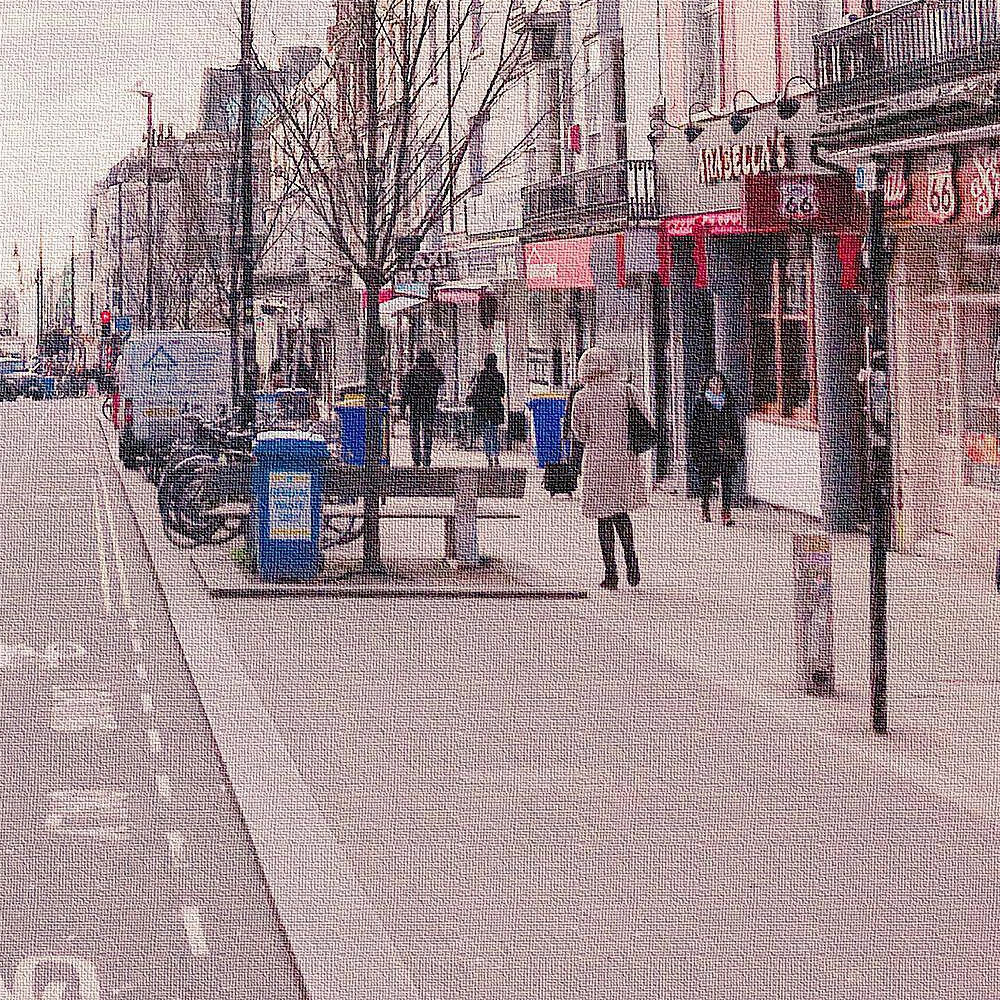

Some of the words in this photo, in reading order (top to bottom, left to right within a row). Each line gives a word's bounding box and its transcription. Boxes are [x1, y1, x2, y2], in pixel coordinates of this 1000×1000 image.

[698, 131, 787, 185] ARABELLA'S
[786, 197, 813, 214] 66
[928, 176, 953, 214] 66
